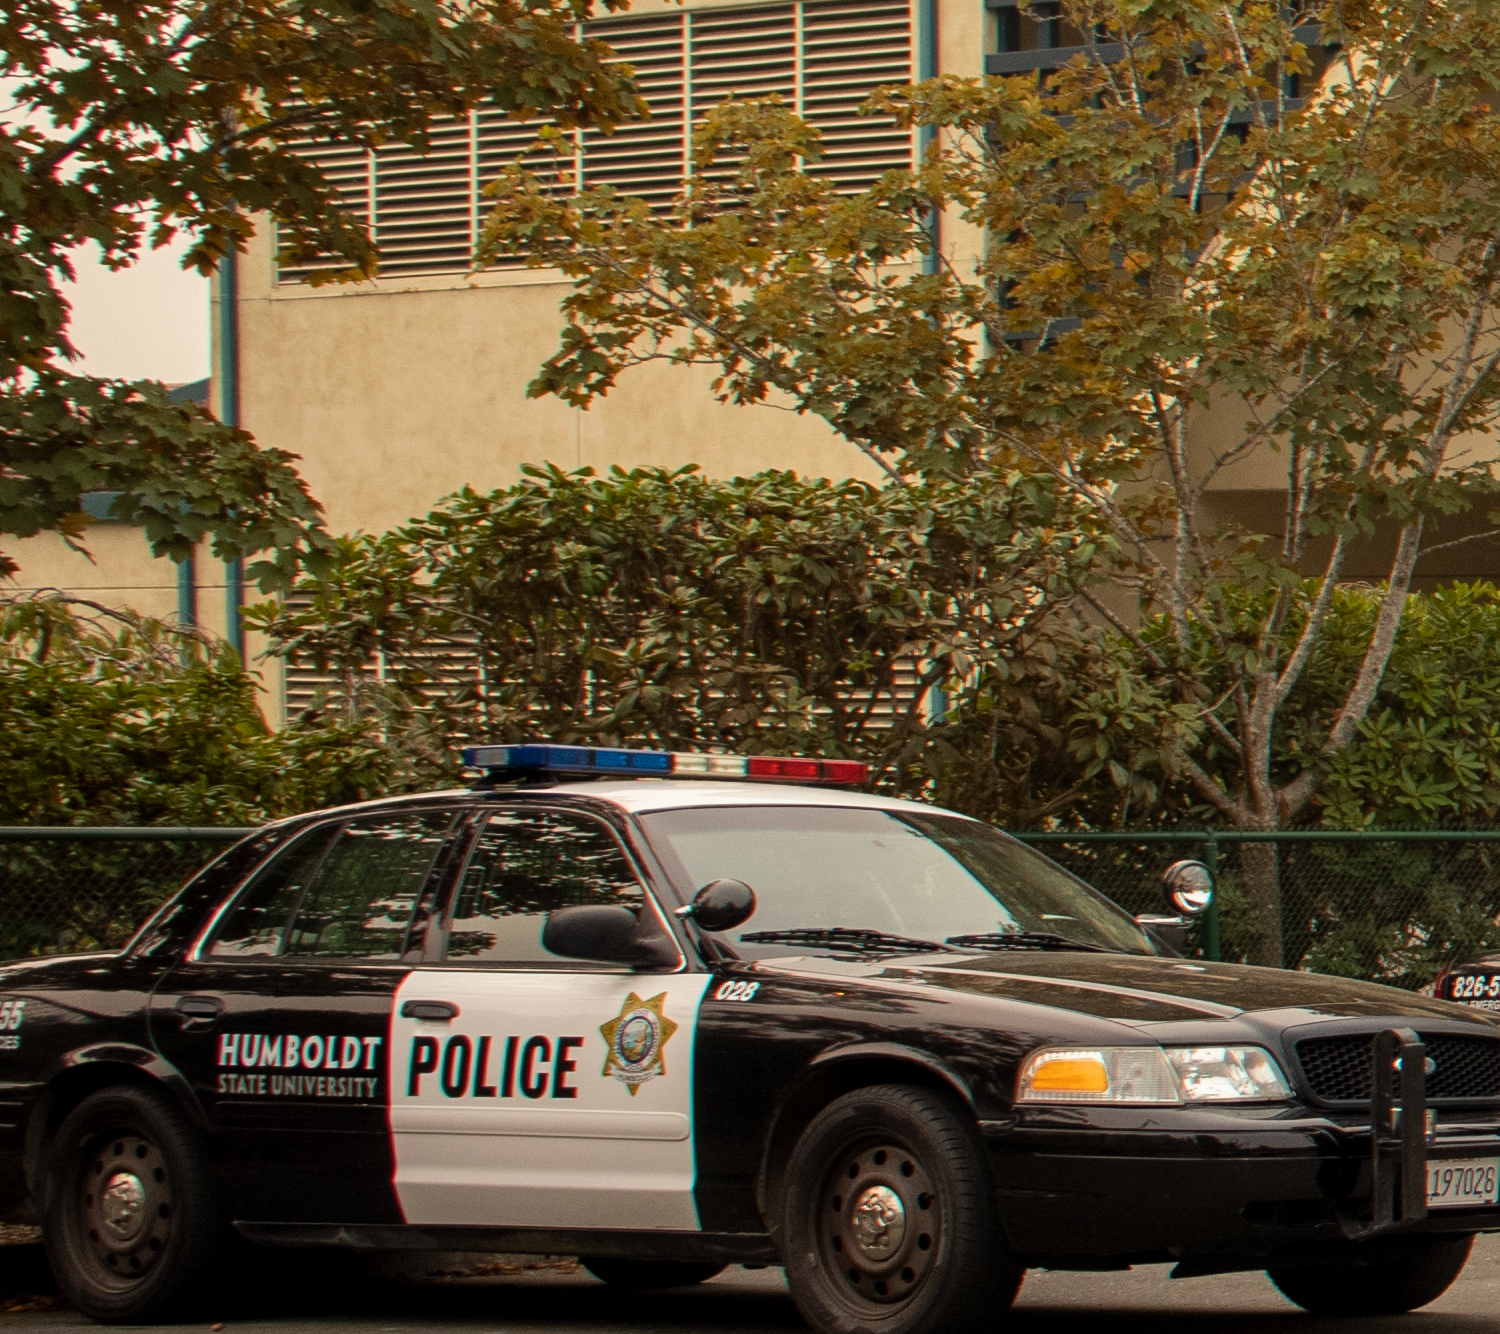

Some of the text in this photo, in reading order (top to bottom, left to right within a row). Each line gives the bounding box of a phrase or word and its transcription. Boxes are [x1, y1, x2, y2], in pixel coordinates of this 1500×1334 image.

[713, 980, 760, 1002] 028
[218, 1033, 383, 1070] HUMBOLDT
[406, 1034, 585, 1099] POLICE
[216, 1073, 378, 1098] STATE UNIVERSITY
